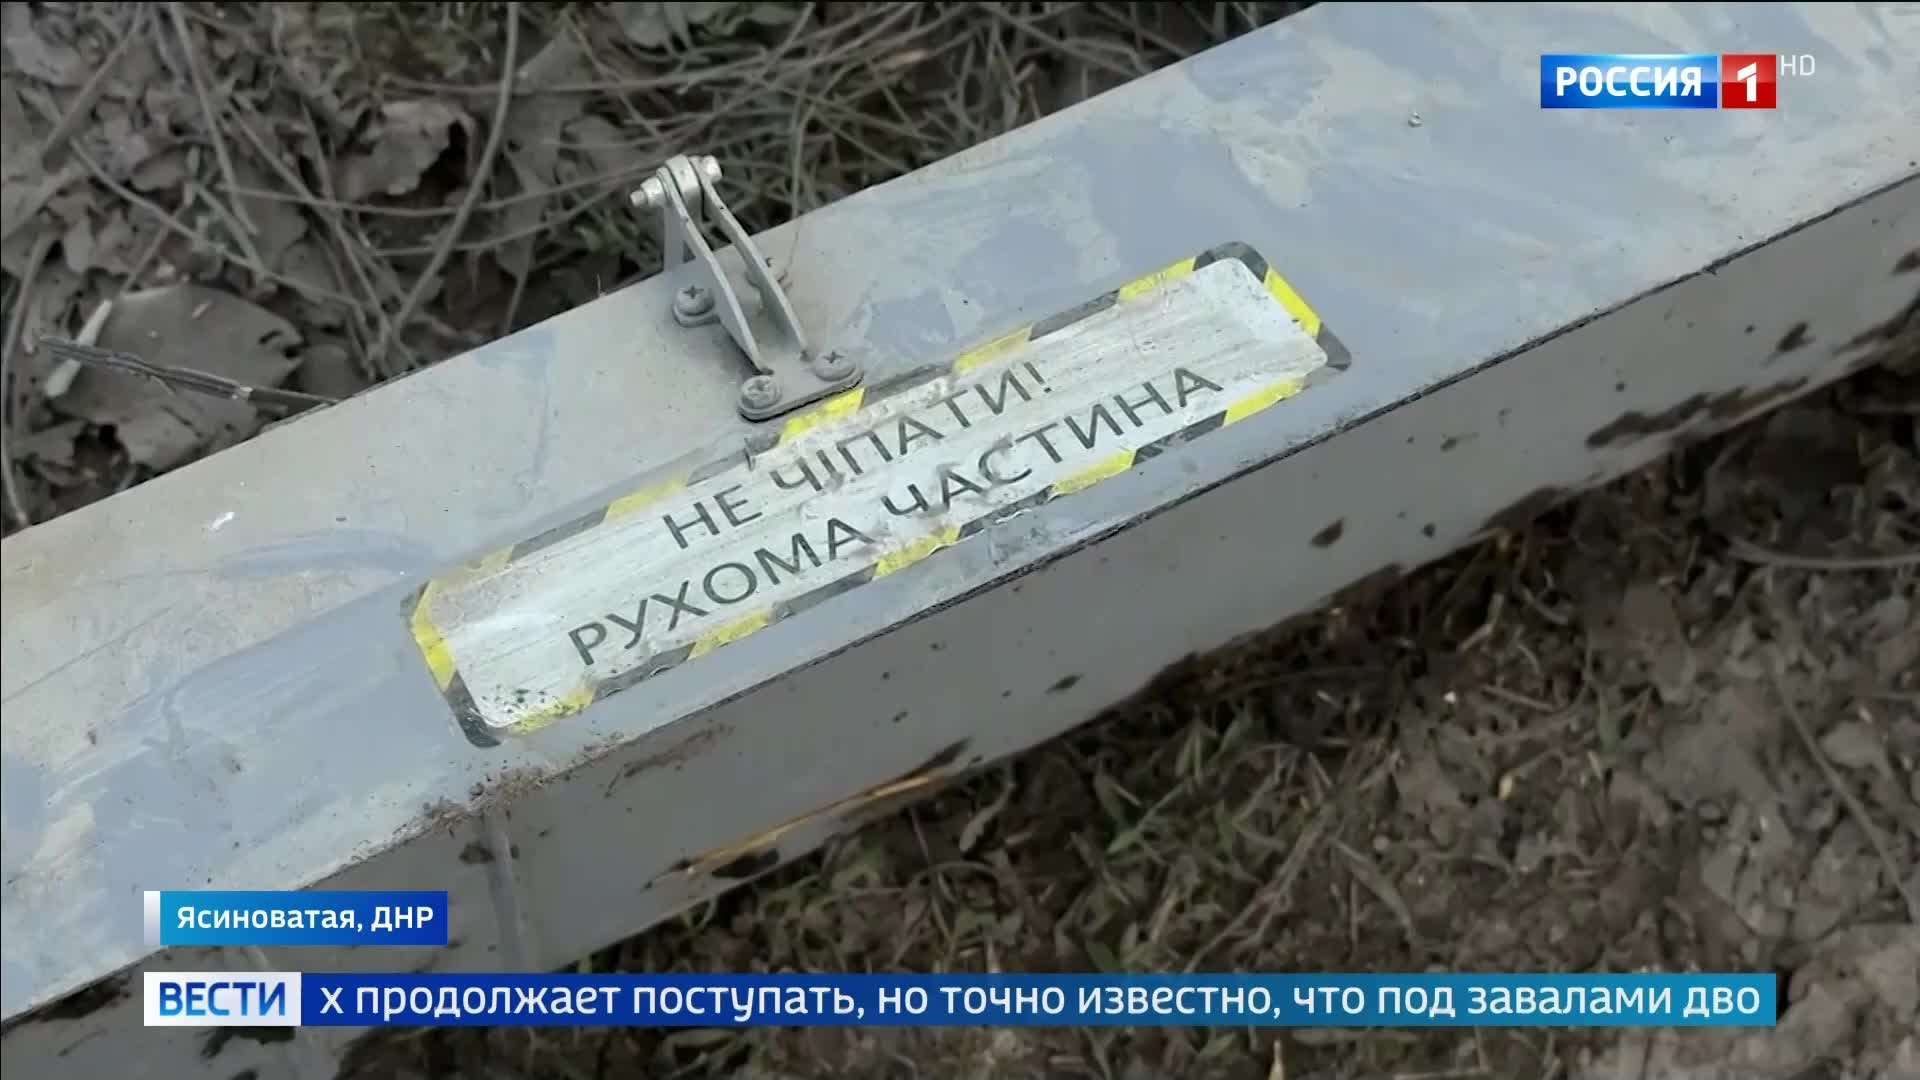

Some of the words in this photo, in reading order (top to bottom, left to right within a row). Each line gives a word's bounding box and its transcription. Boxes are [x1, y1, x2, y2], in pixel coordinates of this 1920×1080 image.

[568, 517, 877, 666] РУХОМА
[881, 366, 1224, 516] ЧАСТИНА
[663, 484, 762, 549] НЕ
[769, 361, 1053, 492] ЧІПАТИ!
